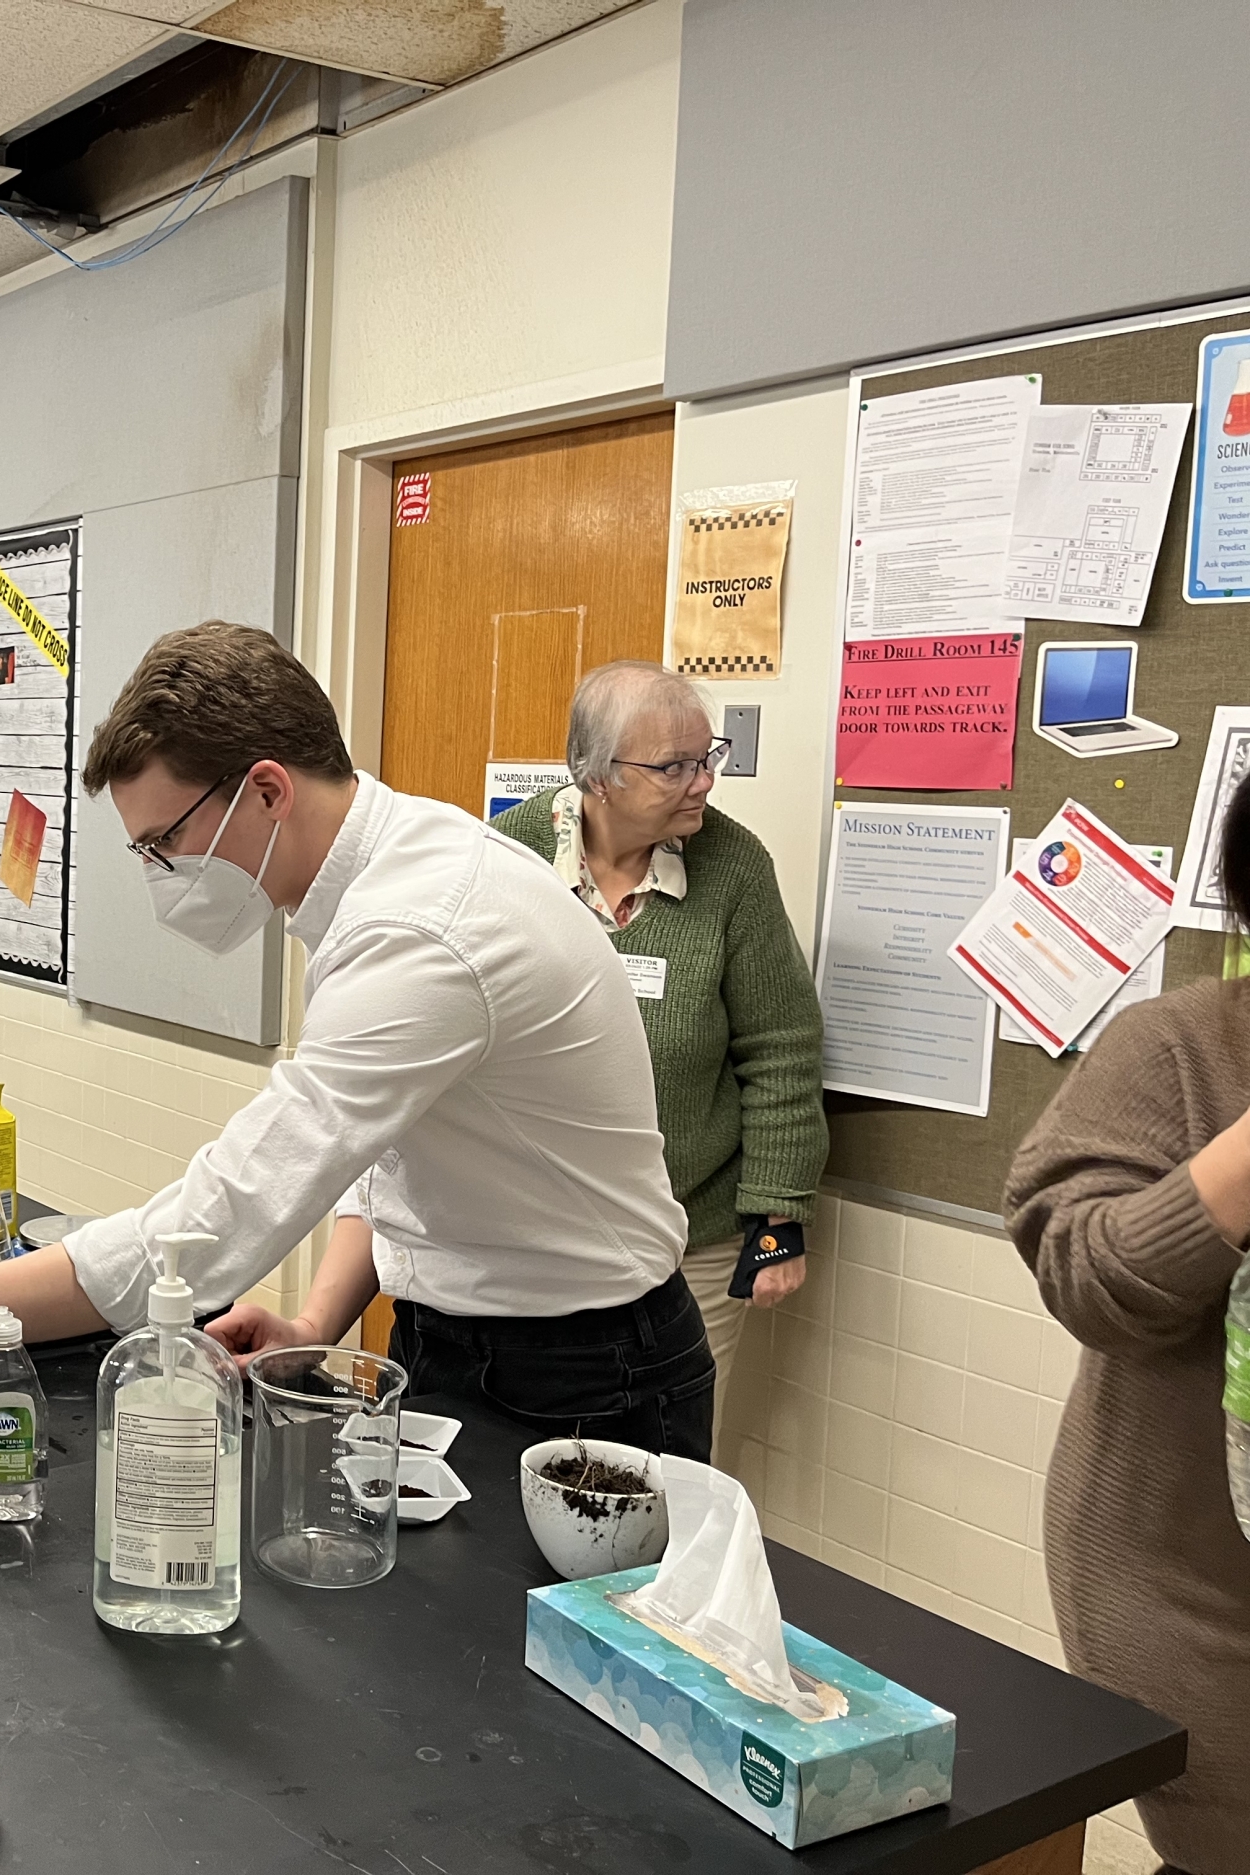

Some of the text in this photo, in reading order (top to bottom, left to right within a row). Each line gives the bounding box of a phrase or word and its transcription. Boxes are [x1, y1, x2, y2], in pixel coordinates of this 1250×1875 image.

[1221, 465, 1250, 473] Observ
[404, 484, 424, 496] FIRE
[1213, 480, 1250, 490] Experime
[1228, 496, 1243, 504] Test
[1218, 511, 1250, 520] Wonder
[1218, 527, 1248, 537] Explore
[1219, 544, 1246, 552] Predict
[1204, 560, 1219, 568] Ask
[686, 576, 772, 594] INSTRUCTORS
[712, 593, 746, 608] ONLY
[8, 588, 24, 617] LINE
[22, 605, 32, 627] DO
[30, 615, 46, 641] NOT
[44, 630, 68, 667] CROSS
[847, 645, 878, 661] FIRE
[884, 644, 926, 659] DRILL
[932, 641, 982, 657] ROOM
[843, 685, 991, 700] KEEP LEFT AND EXIT
[841, 703, 1008, 716] FROM THE PASSAGEWAY
[839, 721, 1008, 734] DOOR TOWARDS TRACK.
[494, 773, 569, 784] HAZARDOUS MATERIALS
[843, 819, 996, 841] MISSION STATEMENT
[627, 958, 657, 966] VISITOR
[744, 1745, 780, 1780] Kleenex
[742, 1765, 780, 1793] PROFESSIONAL
[749, 1778, 772, 1798] comfort
[752, 1786, 770, 1802] touch
